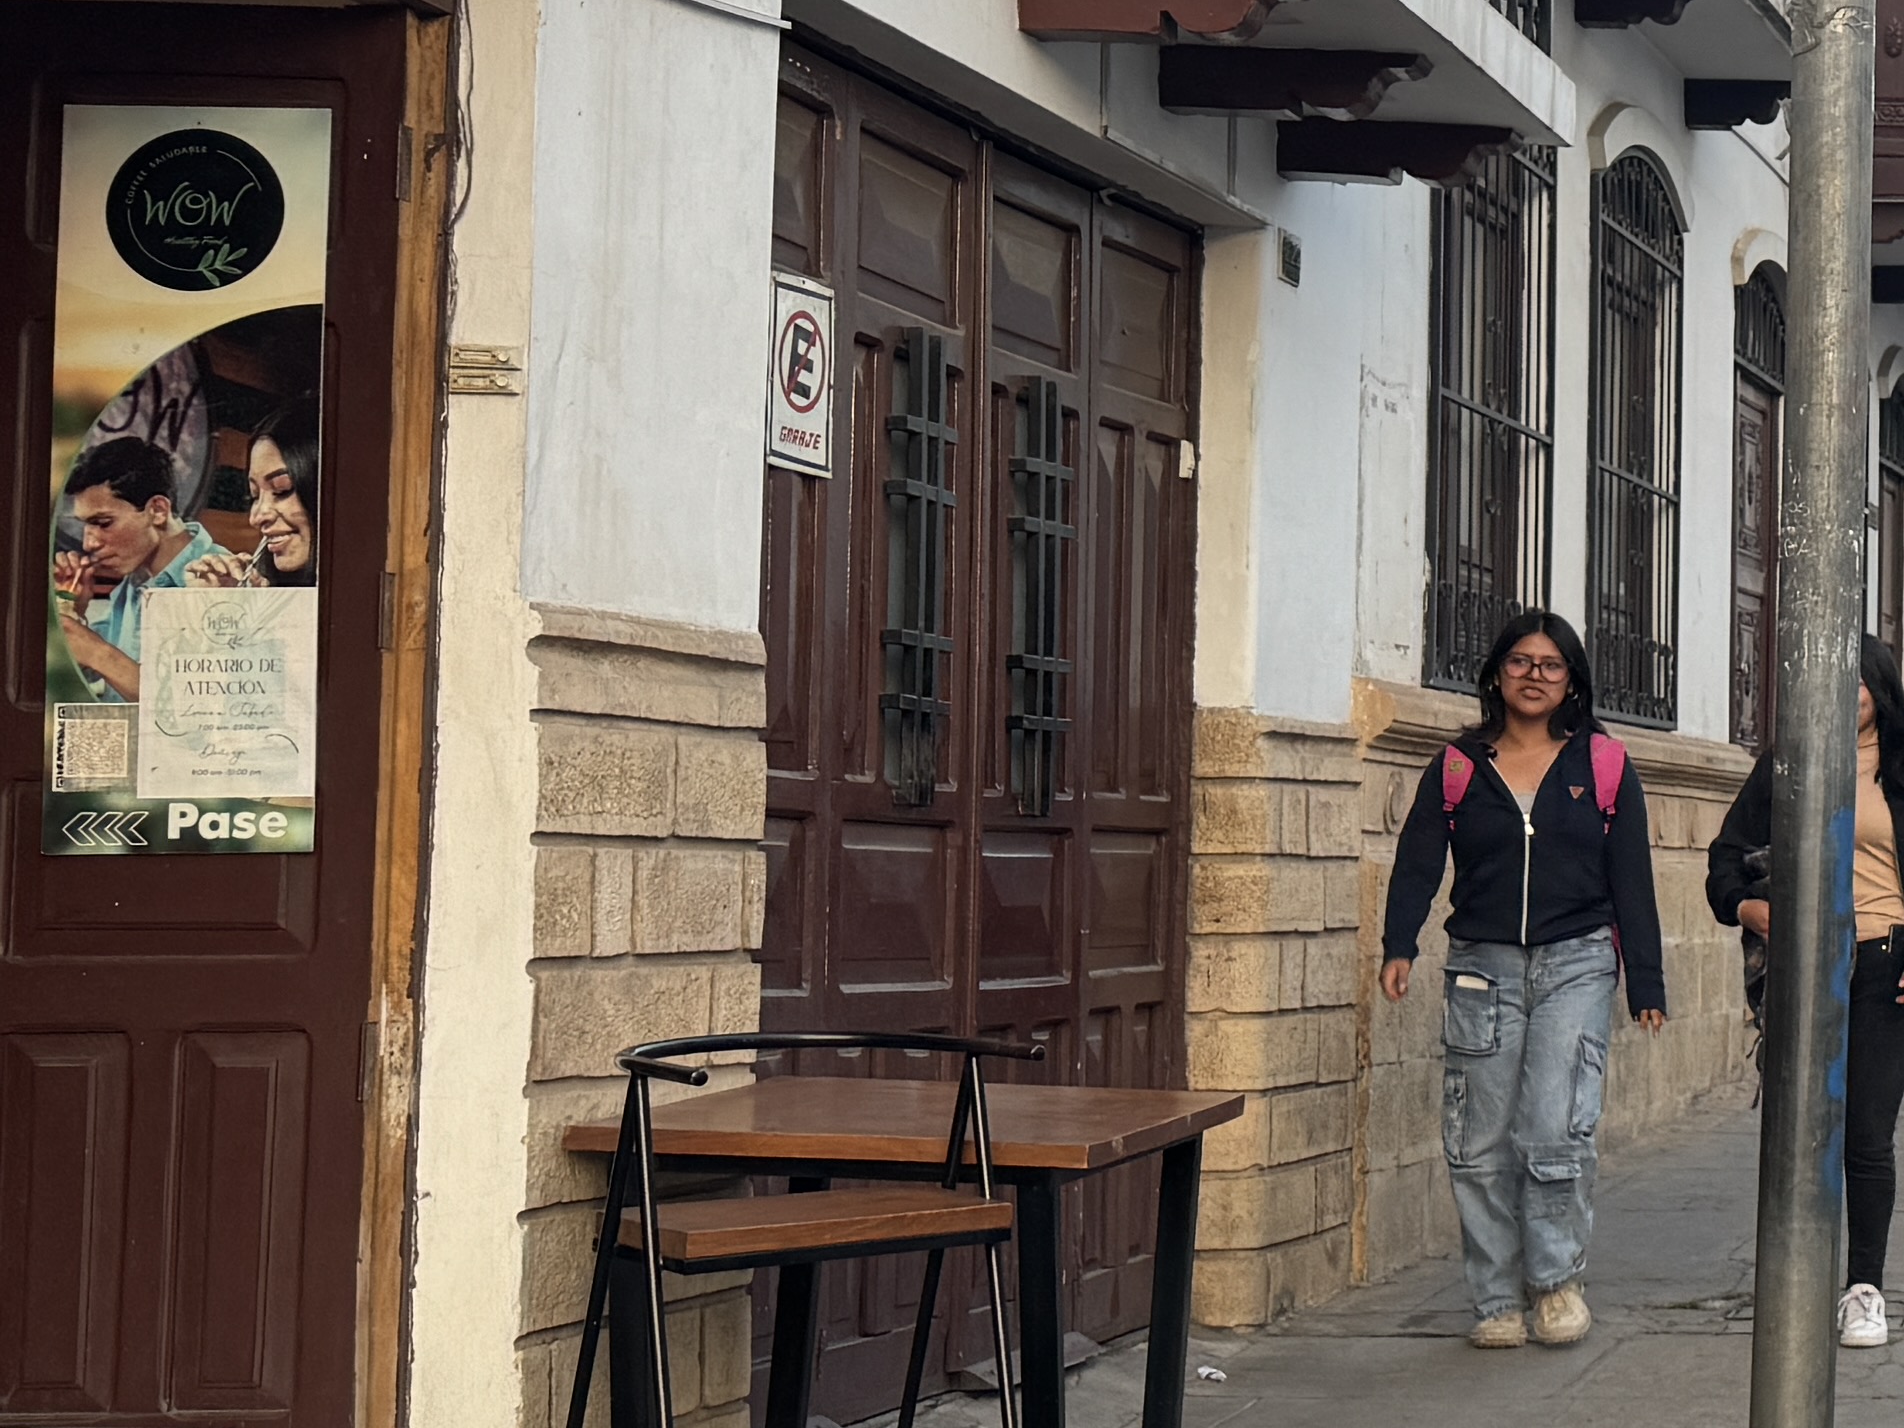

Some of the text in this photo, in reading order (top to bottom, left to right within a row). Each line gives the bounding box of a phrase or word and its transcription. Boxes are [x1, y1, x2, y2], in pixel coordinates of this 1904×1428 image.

[143, 181, 254, 226] WOW
[175, 658, 282, 673] HORARIO DE
[167, 802, 288, 840] Pase
